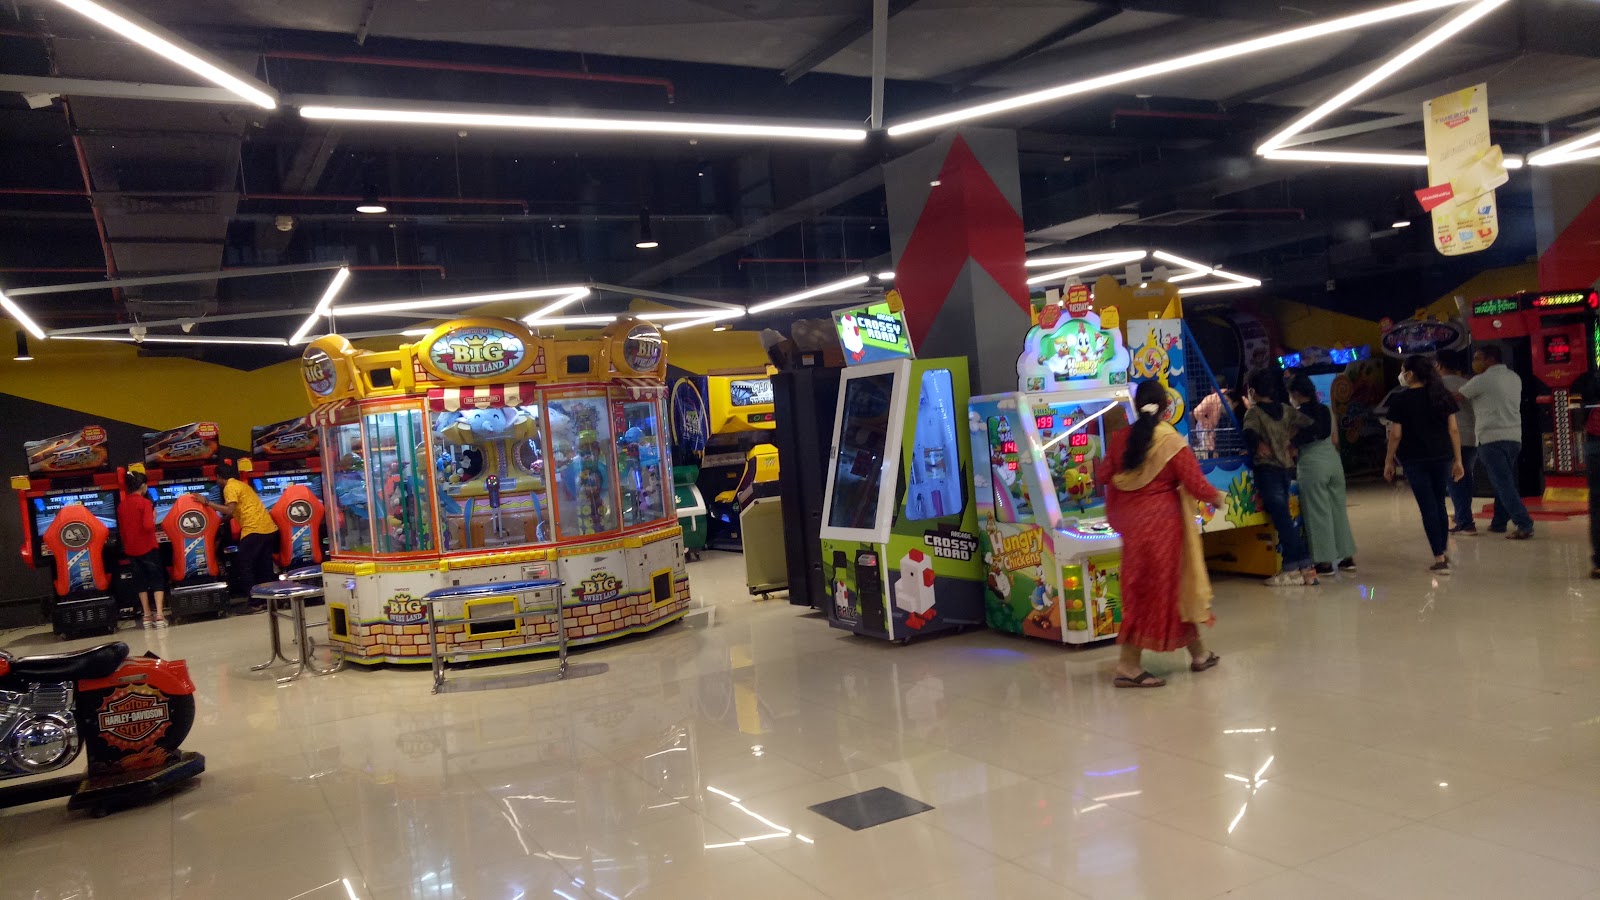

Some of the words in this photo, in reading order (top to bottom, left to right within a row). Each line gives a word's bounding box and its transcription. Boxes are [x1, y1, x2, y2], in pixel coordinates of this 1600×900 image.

[857, 316, 901, 335] CROSSY
[866, 328, 898, 343] ROAD
[450, 343, 504, 363] BIG
[452, 363, 481, 373] SWEET
[481, 361, 505, 372] LAND
[924, 534, 976, 552] CROSSY
[989, 527, 1043, 556] Hungry
[934, 546, 970, 560] ROAD
[1004, 552, 1041, 570] Chickens
[581, 576, 616, 595] BIG
[388, 599, 422, 614] BIG
[406, 613, 423, 621] LAND
[117, 701, 149, 712] MOTOR
[104, 707, 164, 726] HARLEY-DAVIDSON
